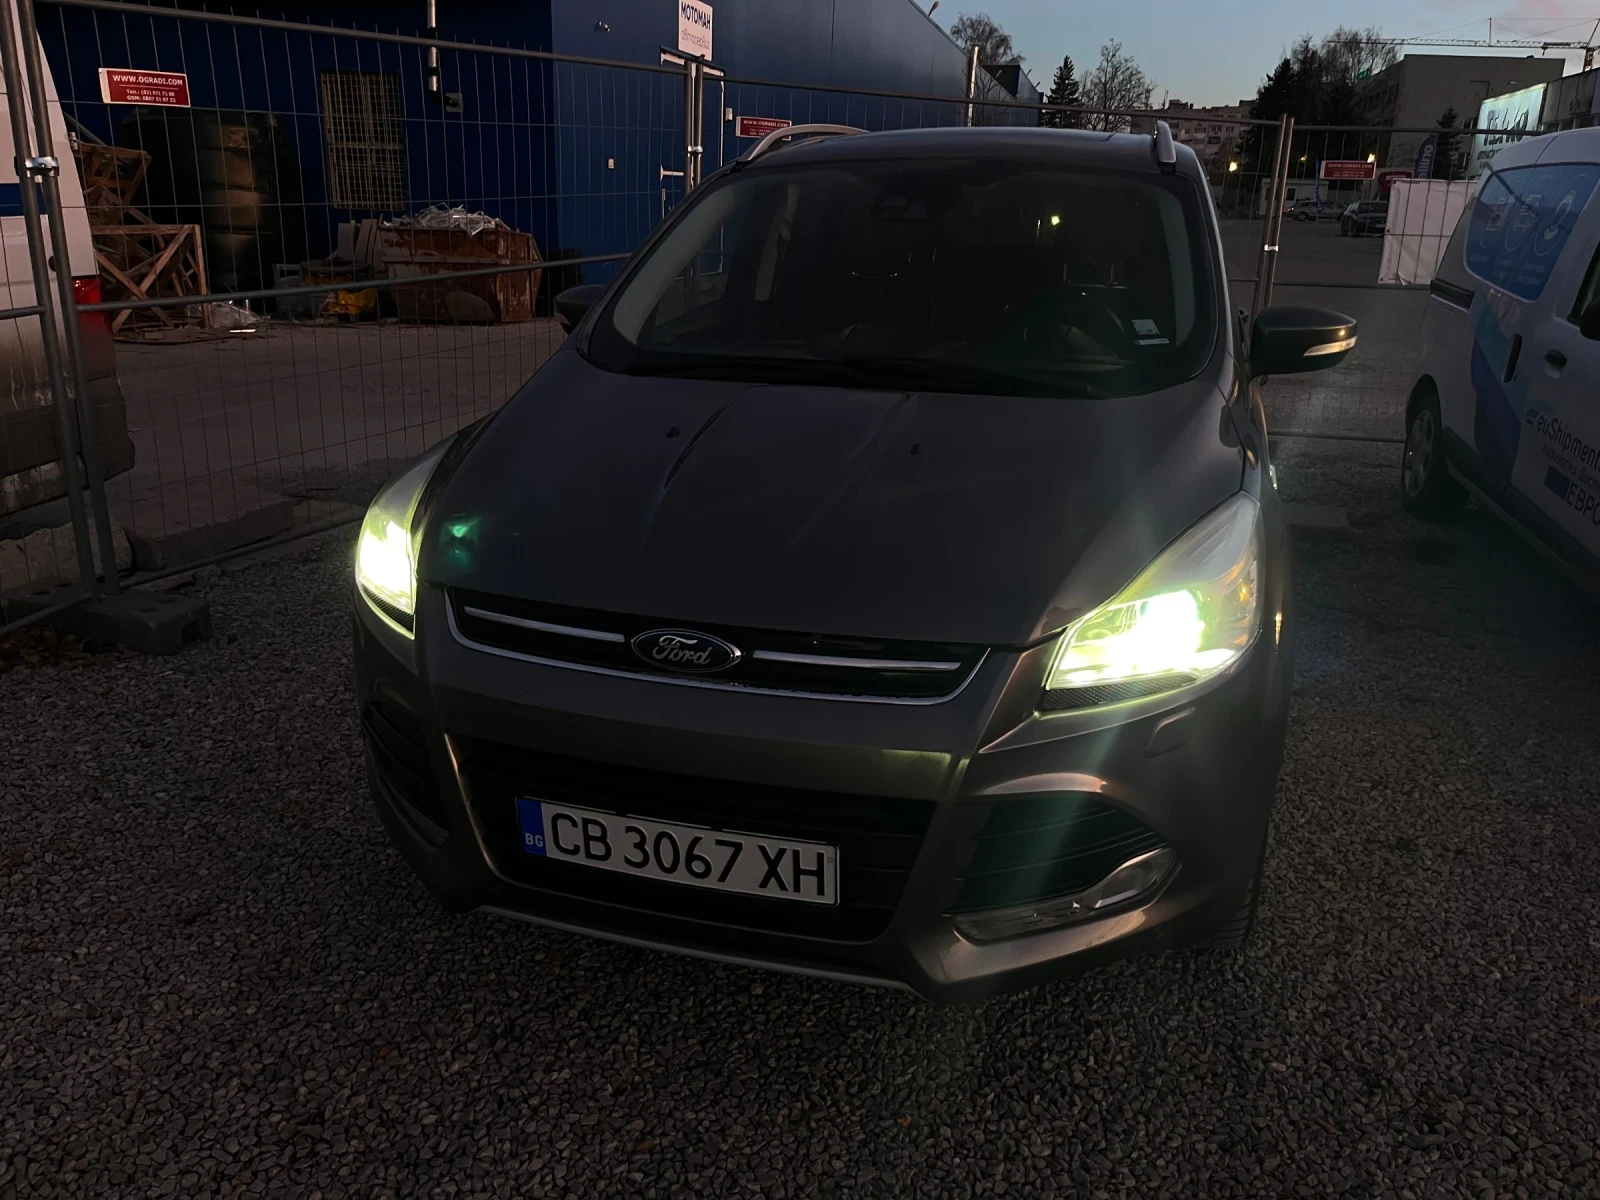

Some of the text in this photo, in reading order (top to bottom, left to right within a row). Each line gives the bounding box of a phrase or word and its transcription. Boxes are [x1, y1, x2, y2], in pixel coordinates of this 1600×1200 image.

[112, 74, 183, 86] WWW.OGRADI.COM
[652, 635, 713, 665] Ford
[525, 832, 544, 848] BG
[624, 825, 744, 883] 3067
